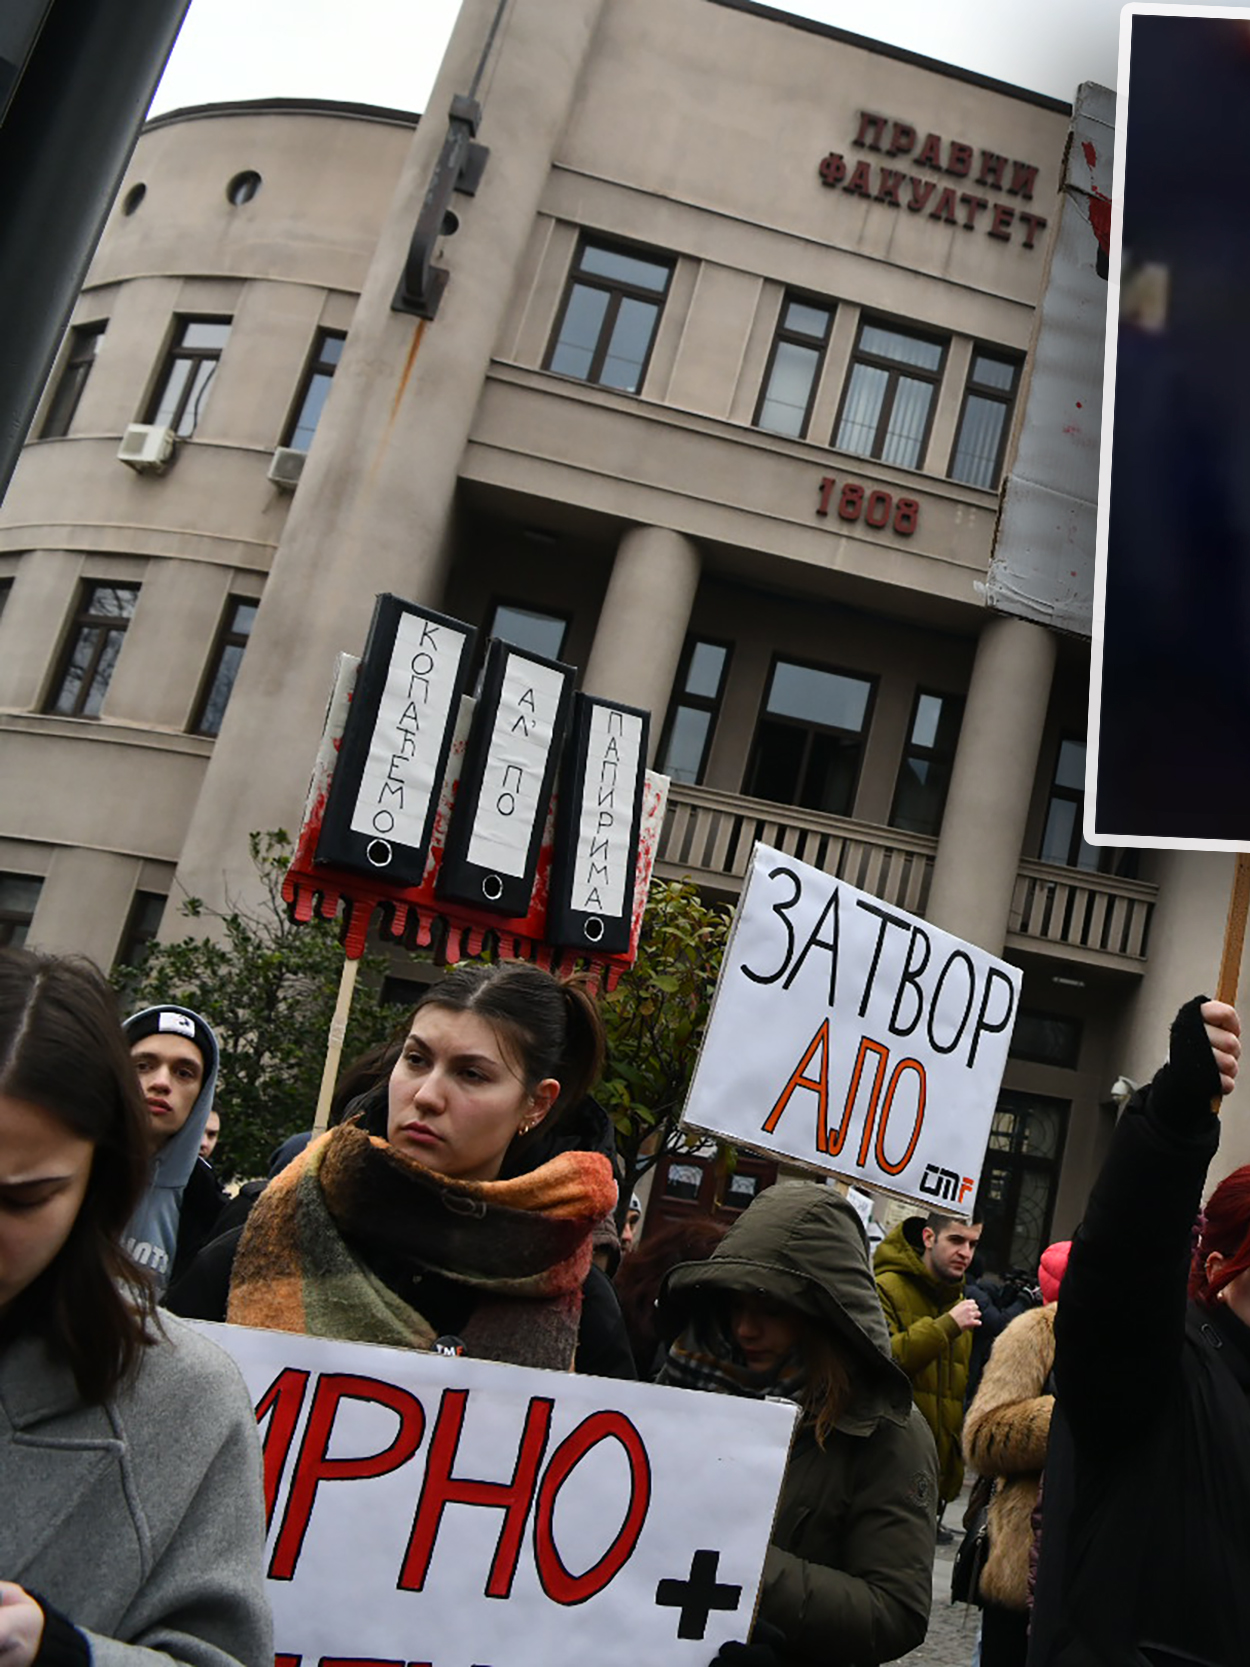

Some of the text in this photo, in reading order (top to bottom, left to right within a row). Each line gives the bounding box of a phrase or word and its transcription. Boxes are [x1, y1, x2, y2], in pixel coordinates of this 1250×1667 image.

[819, 152, 1047, 249] ФАКУЛТЕТ
[851, 111, 1039, 201] ПРАВНИ
[815, 476, 920, 535] 1808
[372, 621, 440, 834] КОПАЋЕМО
[496, 765, 523, 816] ПО
[584, 711, 624, 911] ПАПИРИМА
[740, 867, 1014, 1069] ЗАТВОР
[762, 1017, 927, 1176] АЛО
